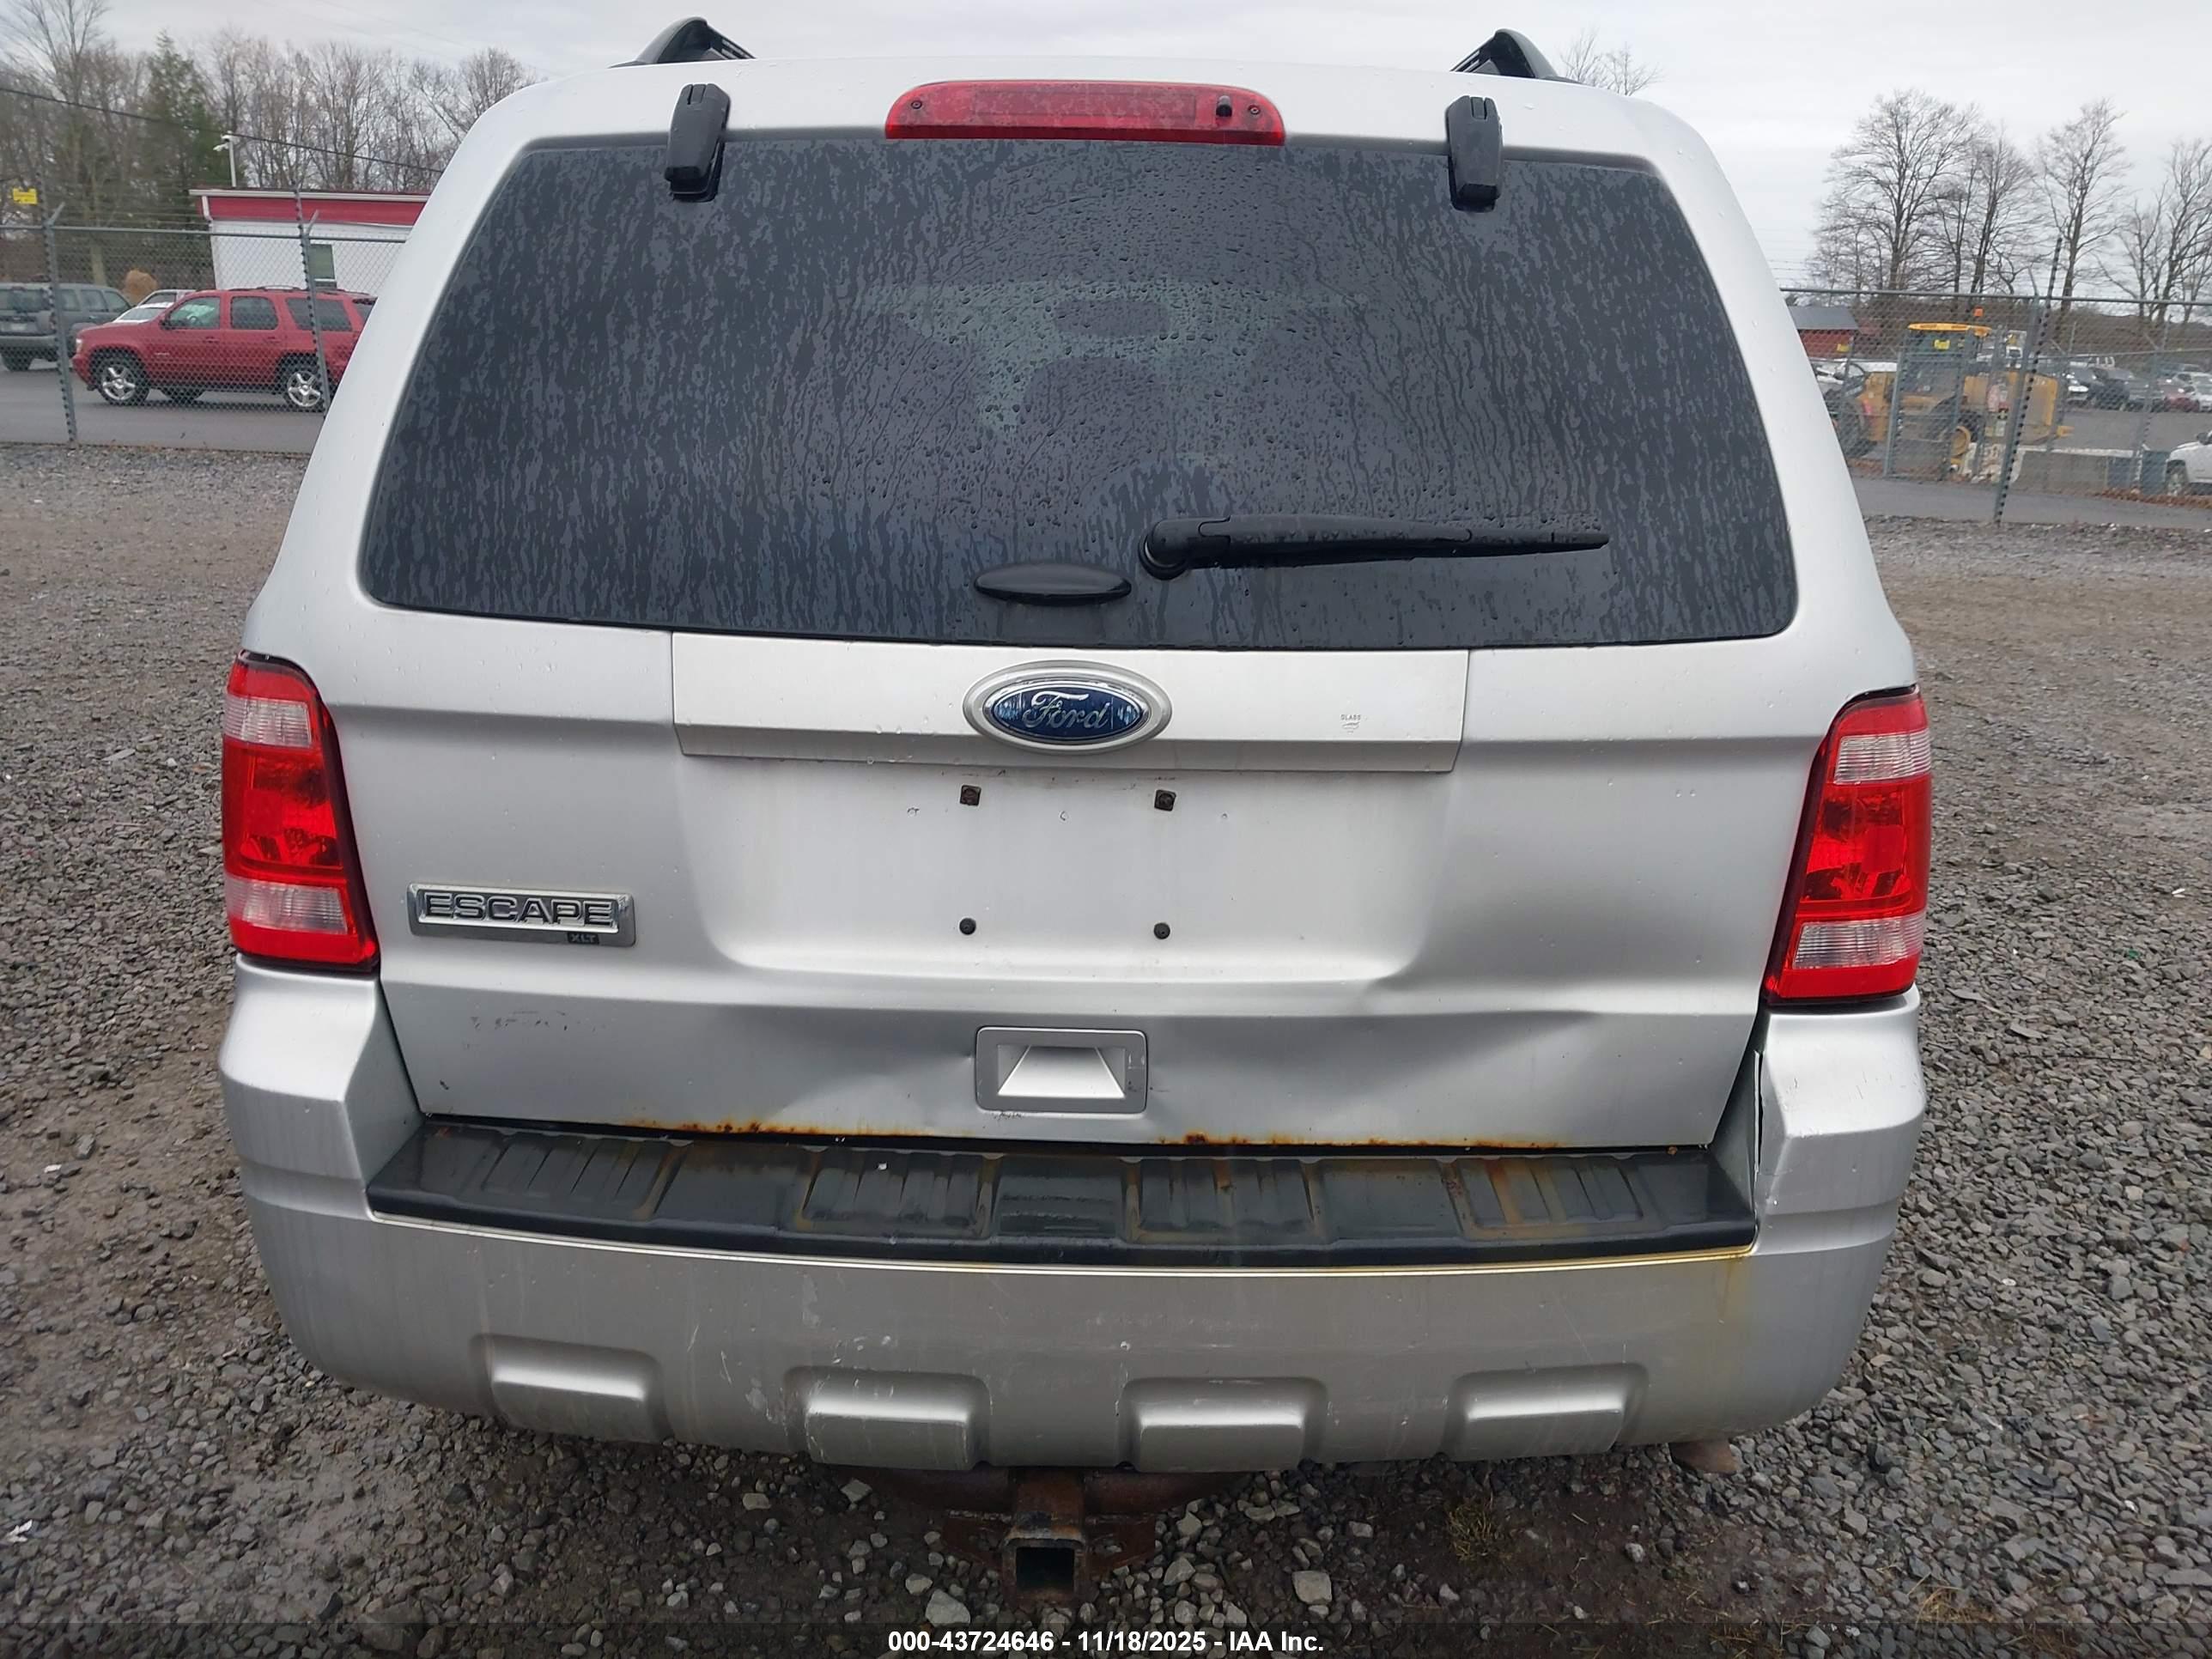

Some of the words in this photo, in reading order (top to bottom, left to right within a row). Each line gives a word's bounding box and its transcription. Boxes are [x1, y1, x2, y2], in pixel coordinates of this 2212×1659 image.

[1023, 690, 1110, 729] Ford
[423, 891, 614, 927] ESCAPE
[569, 933, 598, 944] XLT
